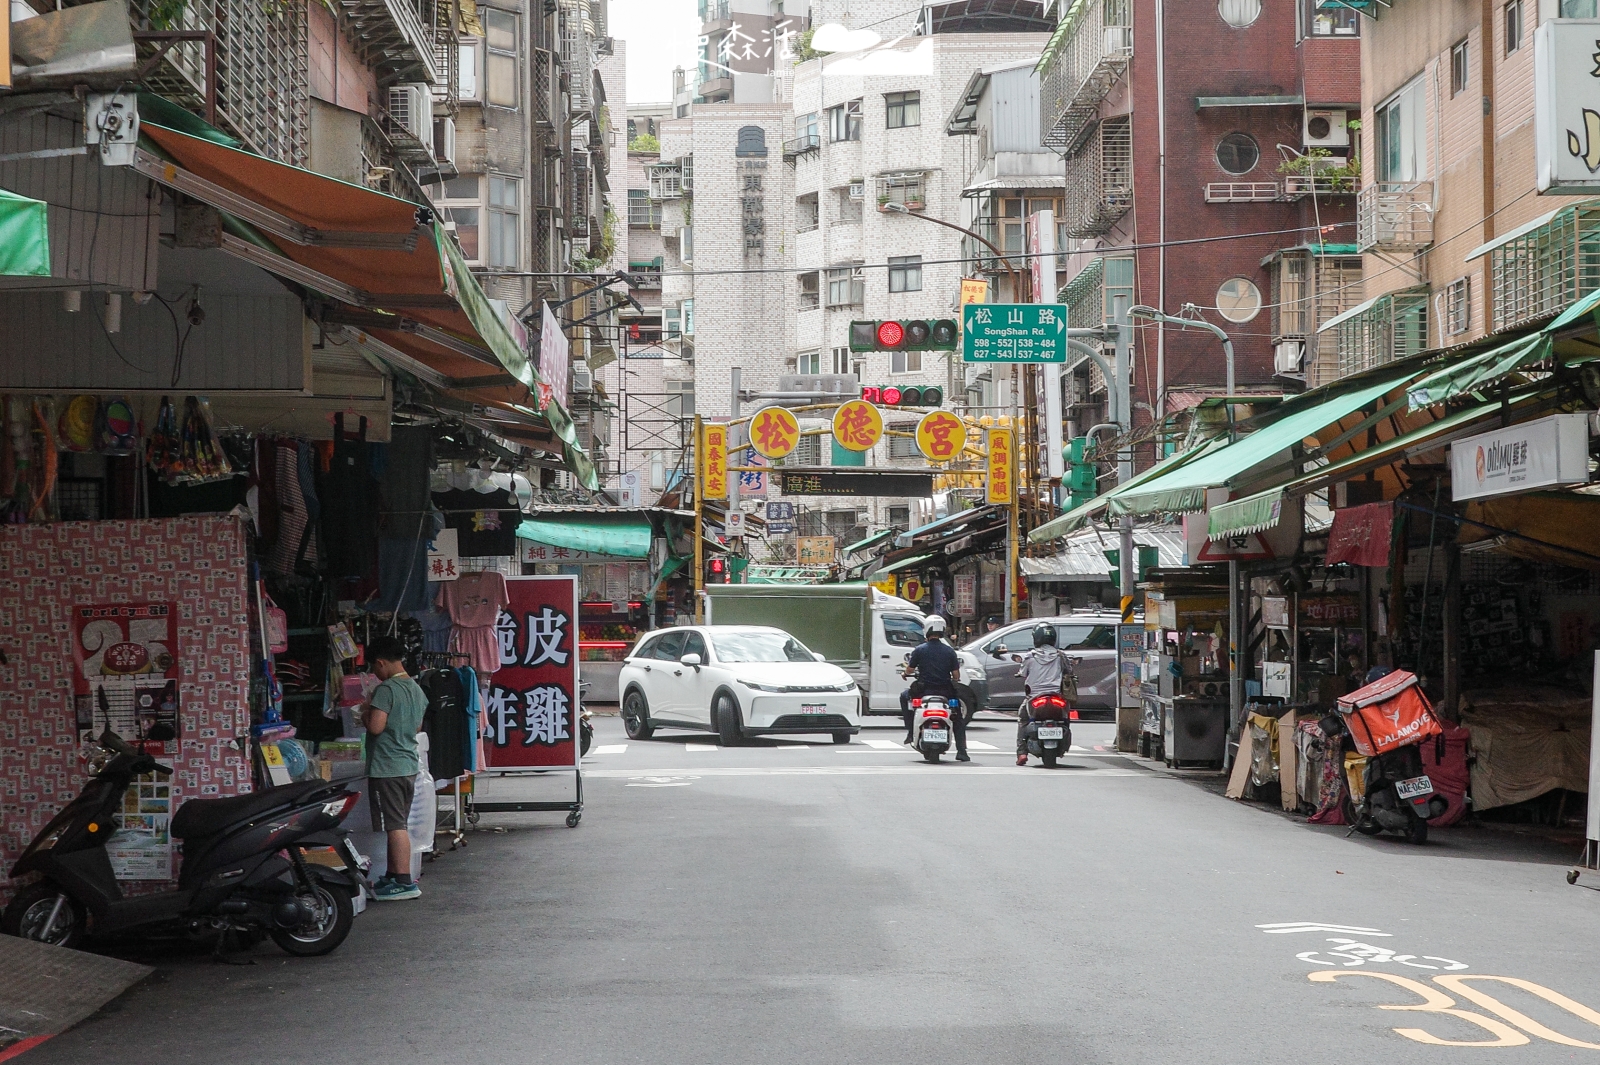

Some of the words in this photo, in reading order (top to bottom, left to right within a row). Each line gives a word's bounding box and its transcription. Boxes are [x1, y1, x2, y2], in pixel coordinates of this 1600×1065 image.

[740, 174, 765, 258] 東都豪門
[964, 285, 984, 294] 松德宮
[975, 308, 1057, 325] 松山路
[984, 327, 1028, 337] SongShan
[1032, 327, 1047, 336] Rd.
[863, 387, 881, 403] 27
[755, 403, 960, 457] 松德宮
[707, 432, 723, 491] 國泰民安
[992, 437, 1007, 496] 風調雨順
[787, 475, 822, 492] 廣進
[81, 607, 119, 617] World
[119, 606, 148, 617] Gym
[1306, 603, 1359, 619] 地瓜球
[111, 644, 141, 657] WORLD
[115, 659, 138, 667] GYM
[1377, 712, 1431, 747] LALAMOVE
[1397, 780, 1432, 795] NAE-0650
[1307, 970, 1600, 1049] 30
